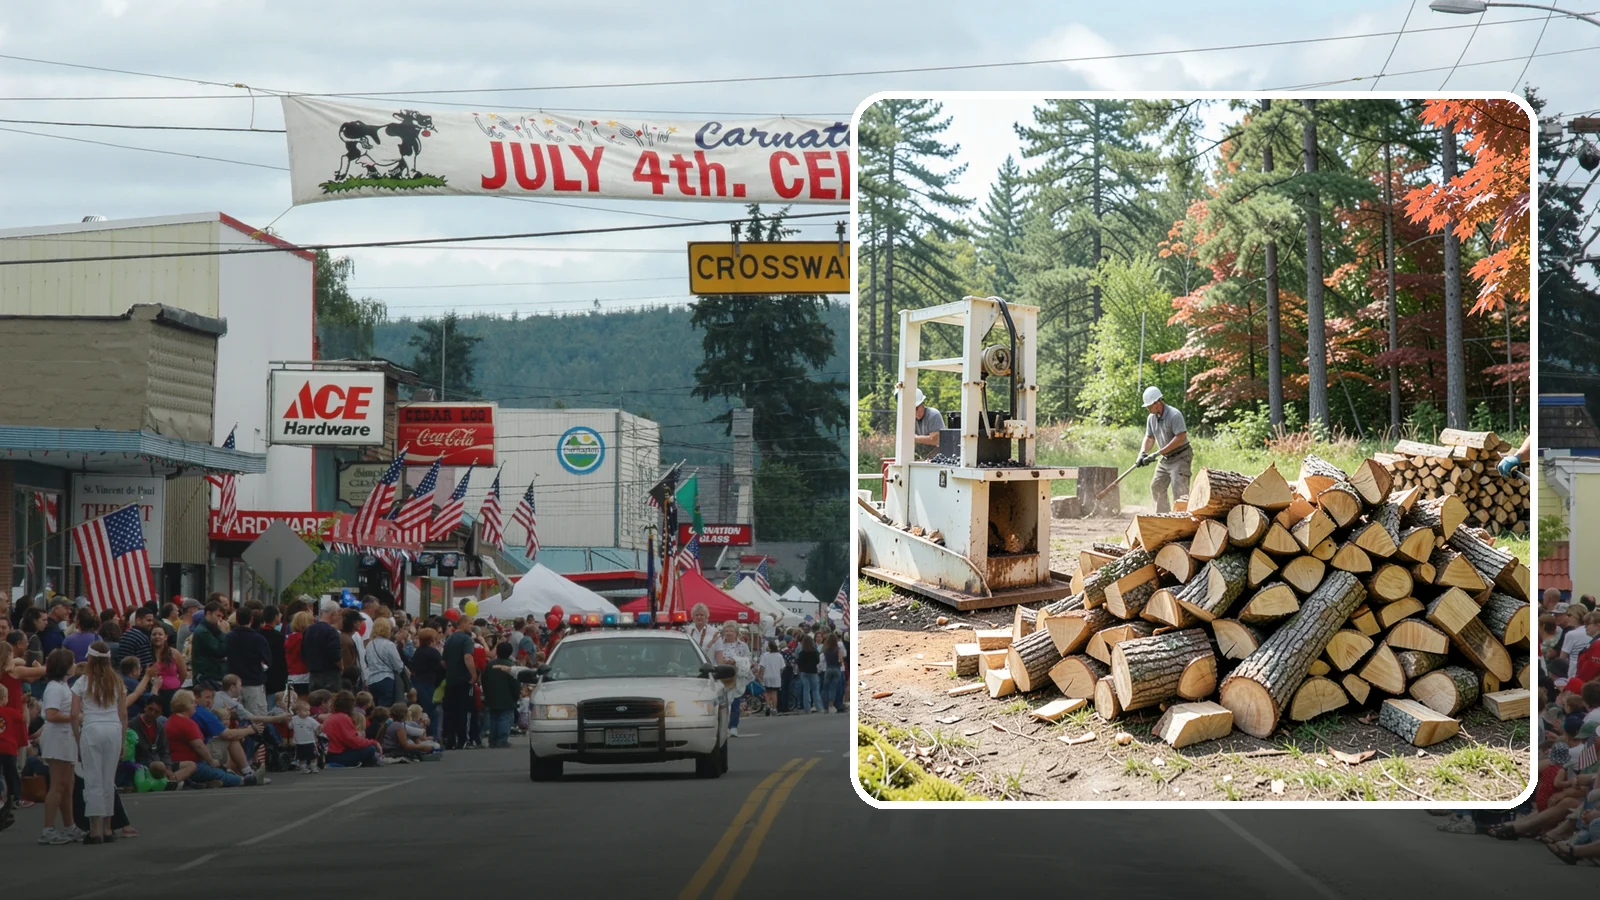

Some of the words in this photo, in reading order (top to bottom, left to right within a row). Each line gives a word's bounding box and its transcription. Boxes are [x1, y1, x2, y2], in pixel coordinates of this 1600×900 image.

[481, 141, 605, 193] JULY
[632, 149, 746, 197] 4th.
[696, 254, 850, 280] CROSSWA
[283, 380, 373, 420] ACE
[405, 409, 452, 422] CEDAR
[283, 421, 371, 436] Hardware
[83, 485, 94, 495] St.
[95, 485, 125, 495] Vincent
[126, 486, 136, 495] de
[137, 486, 155, 495] Paul
[81, 502, 154, 523] THT
[688, 526, 741, 535] CRNATION
[699, 535, 730, 543] GLASS
